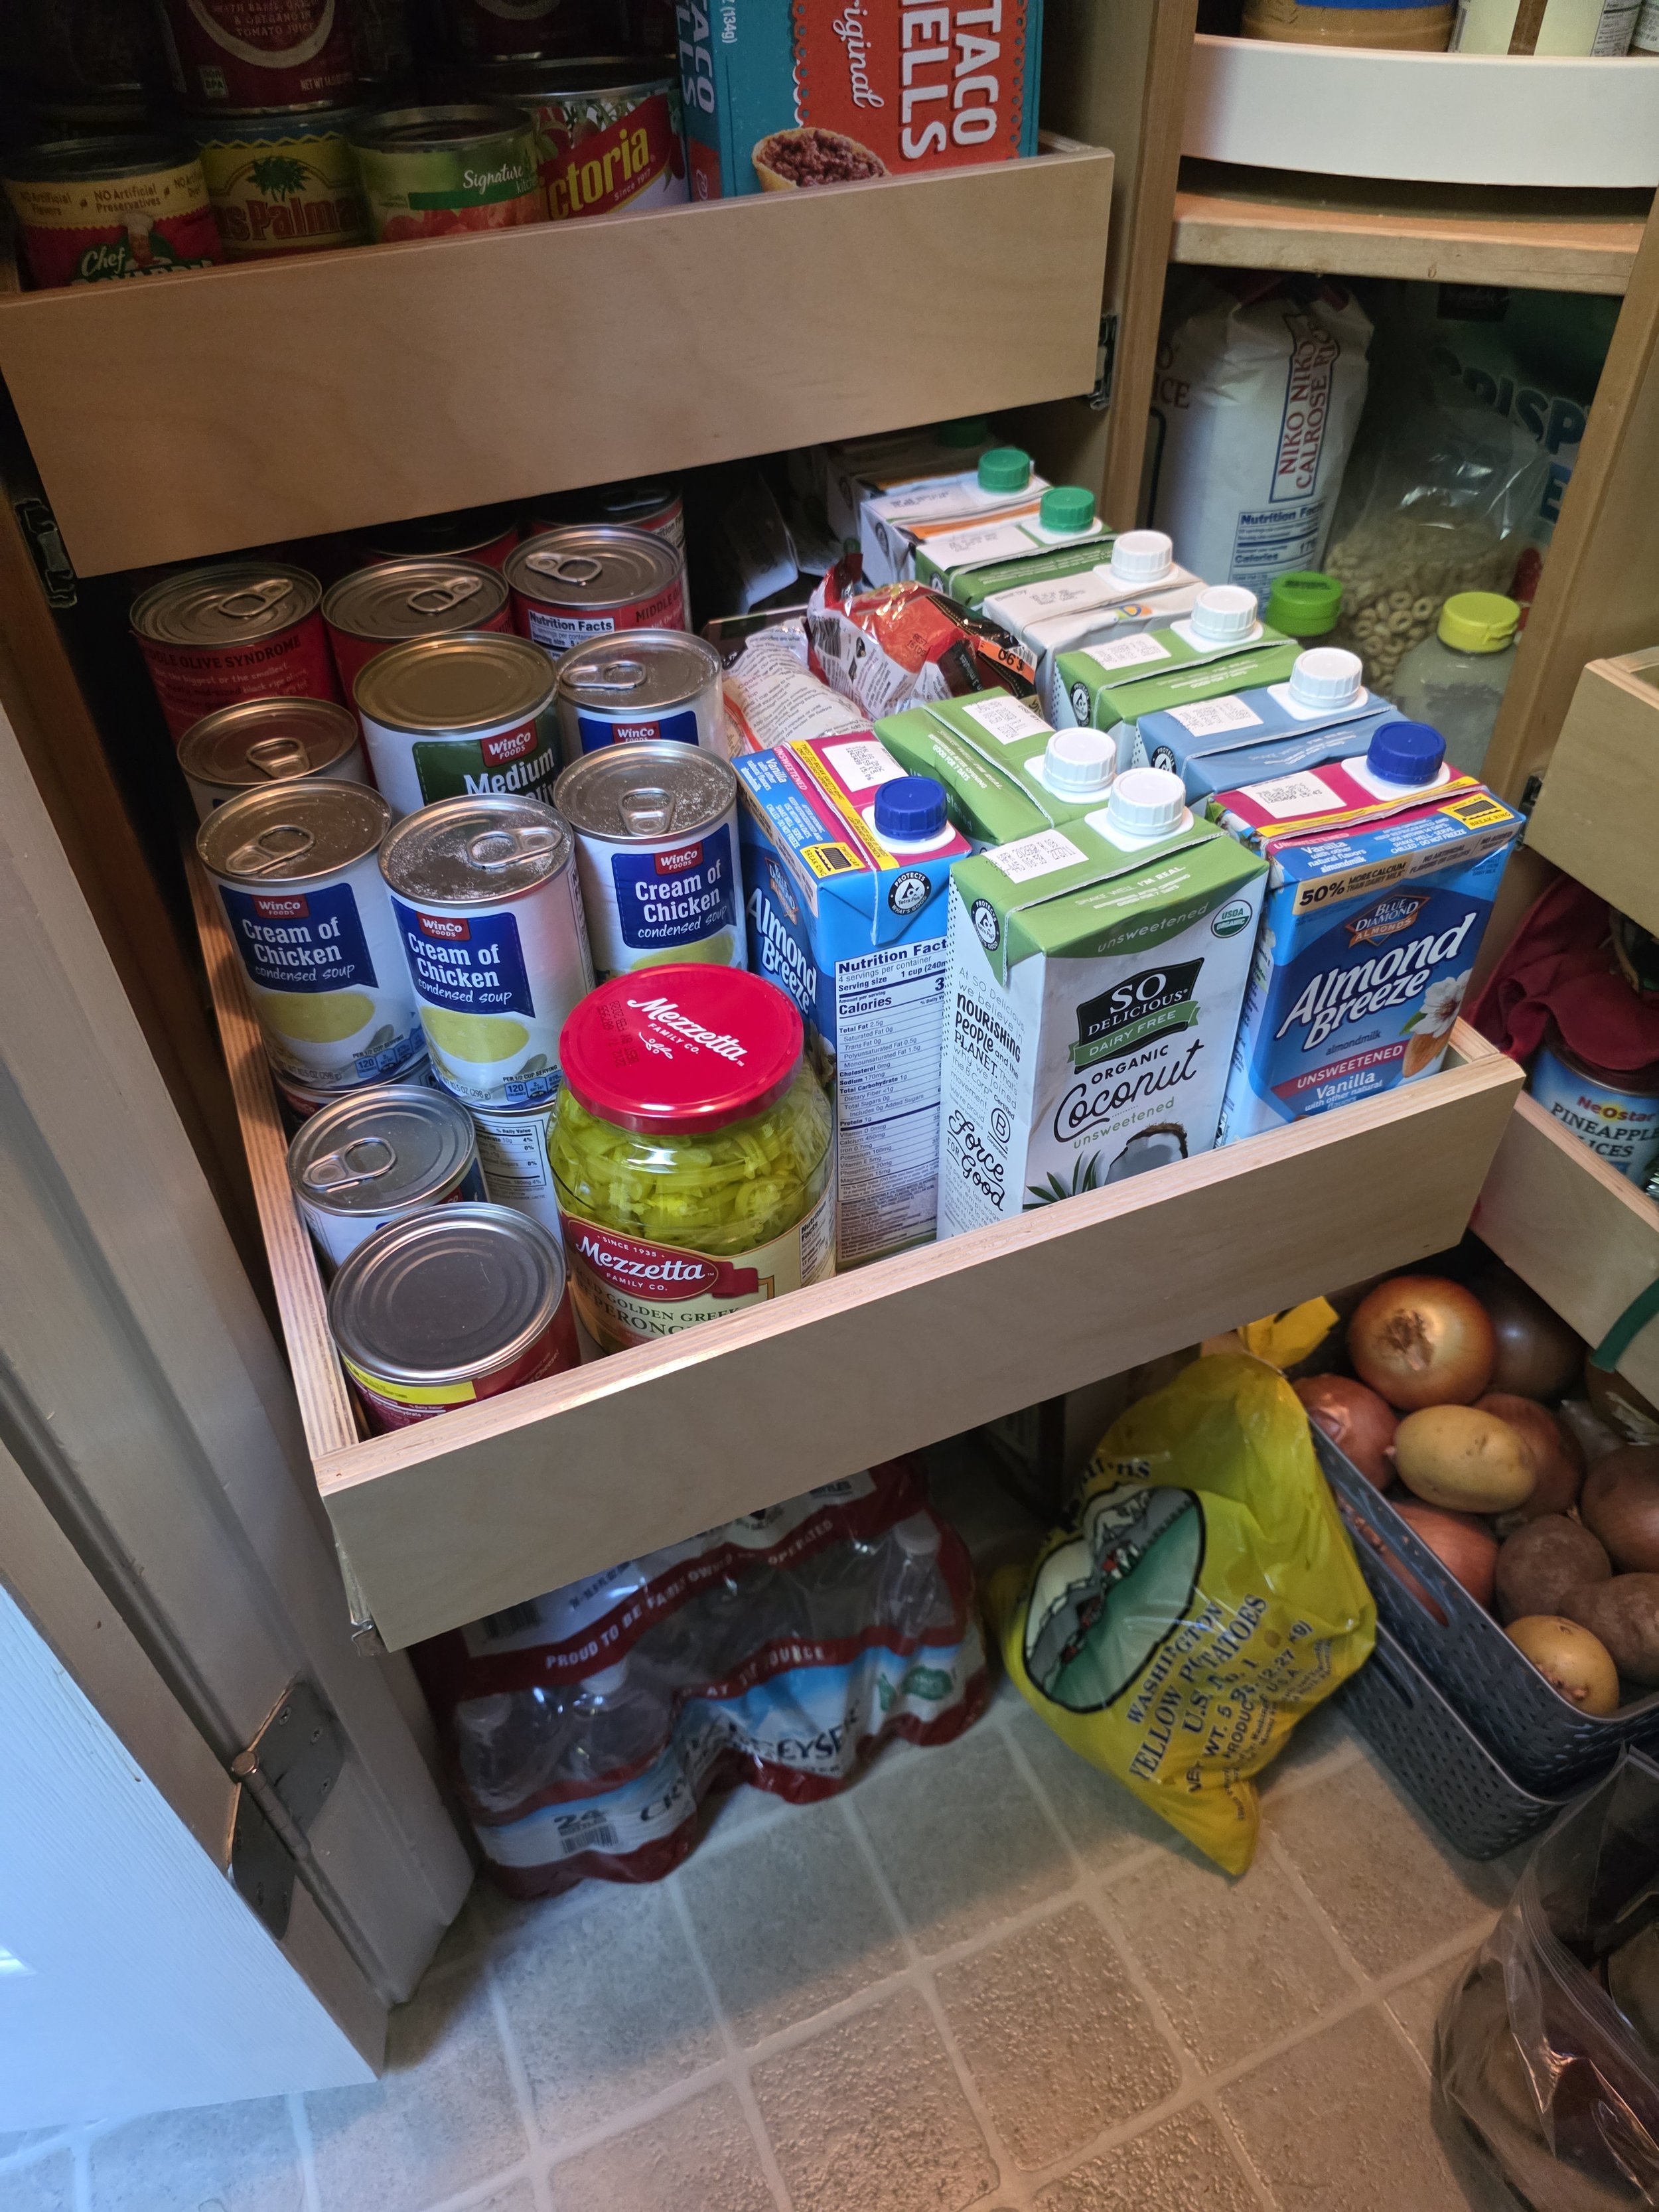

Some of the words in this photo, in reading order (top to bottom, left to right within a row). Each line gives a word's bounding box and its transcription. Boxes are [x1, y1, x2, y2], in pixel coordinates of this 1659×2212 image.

[720, 7, 737, 44] (134g)
[832, 0, 885, 108] iginal
[902, 0, 950, 159] ELLS
[952, 0, 1002, 145] TACO
[463, 163, 524, 195] Signature
[540, 127, 650, 220] ictoria
[614, 183, 635, 201] Since
[636, 169, 651, 184] 1917
[94, 191, 112, 201] NO
[113, 184, 157, 199] Artificial
[96, 197, 161, 213] Preservatives
[80, 246, 125, 277] Chef
[1291, 340, 1315, 403] NIKO
[1153, 374, 1189, 409] ICE
[1279, 412, 1305, 476] NIKO
[1296, 376, 1326, 489] CALROSE
[1241, 512, 1296, 524] Nutrition
[1235, 553, 1278, 563] Calories
[530, 611, 575, 630] Nutrition
[578, 618, 613, 631] Facts
[180, 657, 222, 669] OLIVE
[224, 635, 301, 668] SYNDROME
[960, 654, 977, 680] minutes
[184, 674, 216, 686] biggest
[233, 672, 249, 682] the
[488, 731, 532, 756] WinCo
[616, 727, 655, 739] WinCo
[499, 744, 526, 760] FOODS
[932, 745, 946, 759] GOOD
[945, 757, 956, 768] FOR
[957, 769, 970, 781] DAYS
[463, 748, 555, 796] Medium
[765, 758, 788, 783] Vanilla
[774, 747, 808, 790] UNSWEETENED
[966, 767, 987, 788] OPENING
[660, 848, 698, 867] WinCo
[1301, 841, 1348, 855] Vanilla
[668, 860, 692, 871] FOODS
[1320, 856, 1366, 873] almondmilk
[1348, 871, 1372, 885] MORE
[1372, 862, 1406, 877] CALCIUM
[635, 873, 702, 901] Cream
[707, 859, 722, 885] of
[895, 872, 926, 888] PROTECTS
[1299, 880, 1345, 906] 50%
[258, 901, 301, 911] WinCo
[644, 888, 721, 923] Chicken
[1220, 907, 1244, 921] USDA
[1354, 900, 1419, 932] DIAMOND
[1374, 897, 1406, 917] BLUE
[242, 919, 312, 944] Cream
[319, 917, 341, 939] of
[422, 917, 463, 933] WinCo
[431, 929, 456, 938] FOODS
[637, 915, 701, 938] condensed
[705, 905, 728, 927] soup
[1096, 902, 1210, 954] unsweetened
[1216, 917, 1246, 930] ORGANIC
[1354, 917, 1411, 942] ALMONDS
[253, 942, 342, 966] Chicken
[407, 932, 471, 966] Cream
[478, 944, 501, 966] of
[747, 888, 817, 1005] Almond
[839, 949, 908, 974] Nutrition
[913, 941, 946, 956] Fact
[255, 966, 317, 982] condensed
[323, 964, 355, 979] soup
[417, 957, 500, 988] Chicken
[762, 936, 810, 1015] Breeze
[838, 980, 869, 992] Serving
[871, 976, 887, 985] size
[908, 967, 922, 976] cup
[846, 968, 879, 982] servings
[897, 955, 932, 970] container
[1275, 912, 1477, 1039] Almond
[418, 978, 474, 1003] condensed
[478, 992, 512, 1005] soup
[839, 997, 892, 1015] Calories
[973, 976, 987, 992] SO
[989, 988, 1026, 1034] Delicious,
[1109, 972, 1167, 1014] SO
[977, 992, 1014, 1031] believe
[1087, 990, 1183, 1037] DELICIOUS
[1303, 968, 1430, 1051] Breeze
[627, 997, 748, 1061] Mezzetta
[647, 1023, 684, 1044] FAMILY
[684, 1043, 699, 1054] CO.
[839, 1025, 857, 1033] Total
[843, 1030, 873, 1043] Saturated
[1089, 1028, 1132, 1057] DAIRY
[1137, 1009, 1177, 1033] FREE
[1326, 1029, 1382, 1055] almondmilk
[844, 1043, 893, 1060] Polyunsaturated
[844, 1051, 897, 1069] Monounsaturated
[954, 1029, 998, 1078] PLANET.
[995, 1050, 1009, 1066] and
[1009, 1063, 1019, 1080] the
[1090, 1043, 1170, 1085] ORGANIC
[1297, 1045, 1403, 1088] UNSWEETENED
[536, 1065, 558, 1076] SERVING
[839, 1066, 876, 1078] Cholesterol
[858, 1077, 899, 1091] Carbohydrate
[507, 1084, 524, 1094] 120
[951, 1071, 988, 1111] movement.
[990, 1076, 1017, 1110] joined
[1053, 1038, 1205, 1143] Coconut
[1305, 1100, 1324, 1112] with
[1326, 1090, 1350, 1104] other
[1350, 1080, 1383, 1096] natural
[1316, 1072, 1376, 1100] Vanilla
[993, 1094, 1015, 1120] Certified
[1072, 1096, 1175, 1150] unsweetened
[947, 1137, 960, 1157] FOR
[948, 1109, 1004, 1182] Force
[961, 1154, 1005, 1212] Good
[802, 1201, 826, 1234] Nutrition
[802, 1220, 818, 1242] Facts
[575, 1236, 705, 1281] Mezzetta
[603, 1236, 629, 1250] SINCE
[633, 1247, 657, 1257] 1935
[607, 1272, 644, 1288] FAMILY
[607, 1293, 674, 1321] GOLDEN
[545, 1639, 599, 1670] PROUD
[600, 1624, 620, 1647] TO
[622, 1605, 644, 1630] BE
[768, 1519, 834, 1566] OPERATED
[1126, 1602, 1223, 1724] WASHINGTON
[1242, 1659, 1258, 1669] 1
[706, 1683, 729, 1696] AT
[1129, 1684, 1183, 1781] YELLOW
[1177, 1593, 1267, 1683] POTATOES
[1204, 1725, 1228, 1757] WT.
[1217, 1704, 1232, 1718] 5
[1223, 1698, 1254, 1758] PRODUC
[553, 1809, 607, 1831] 24
